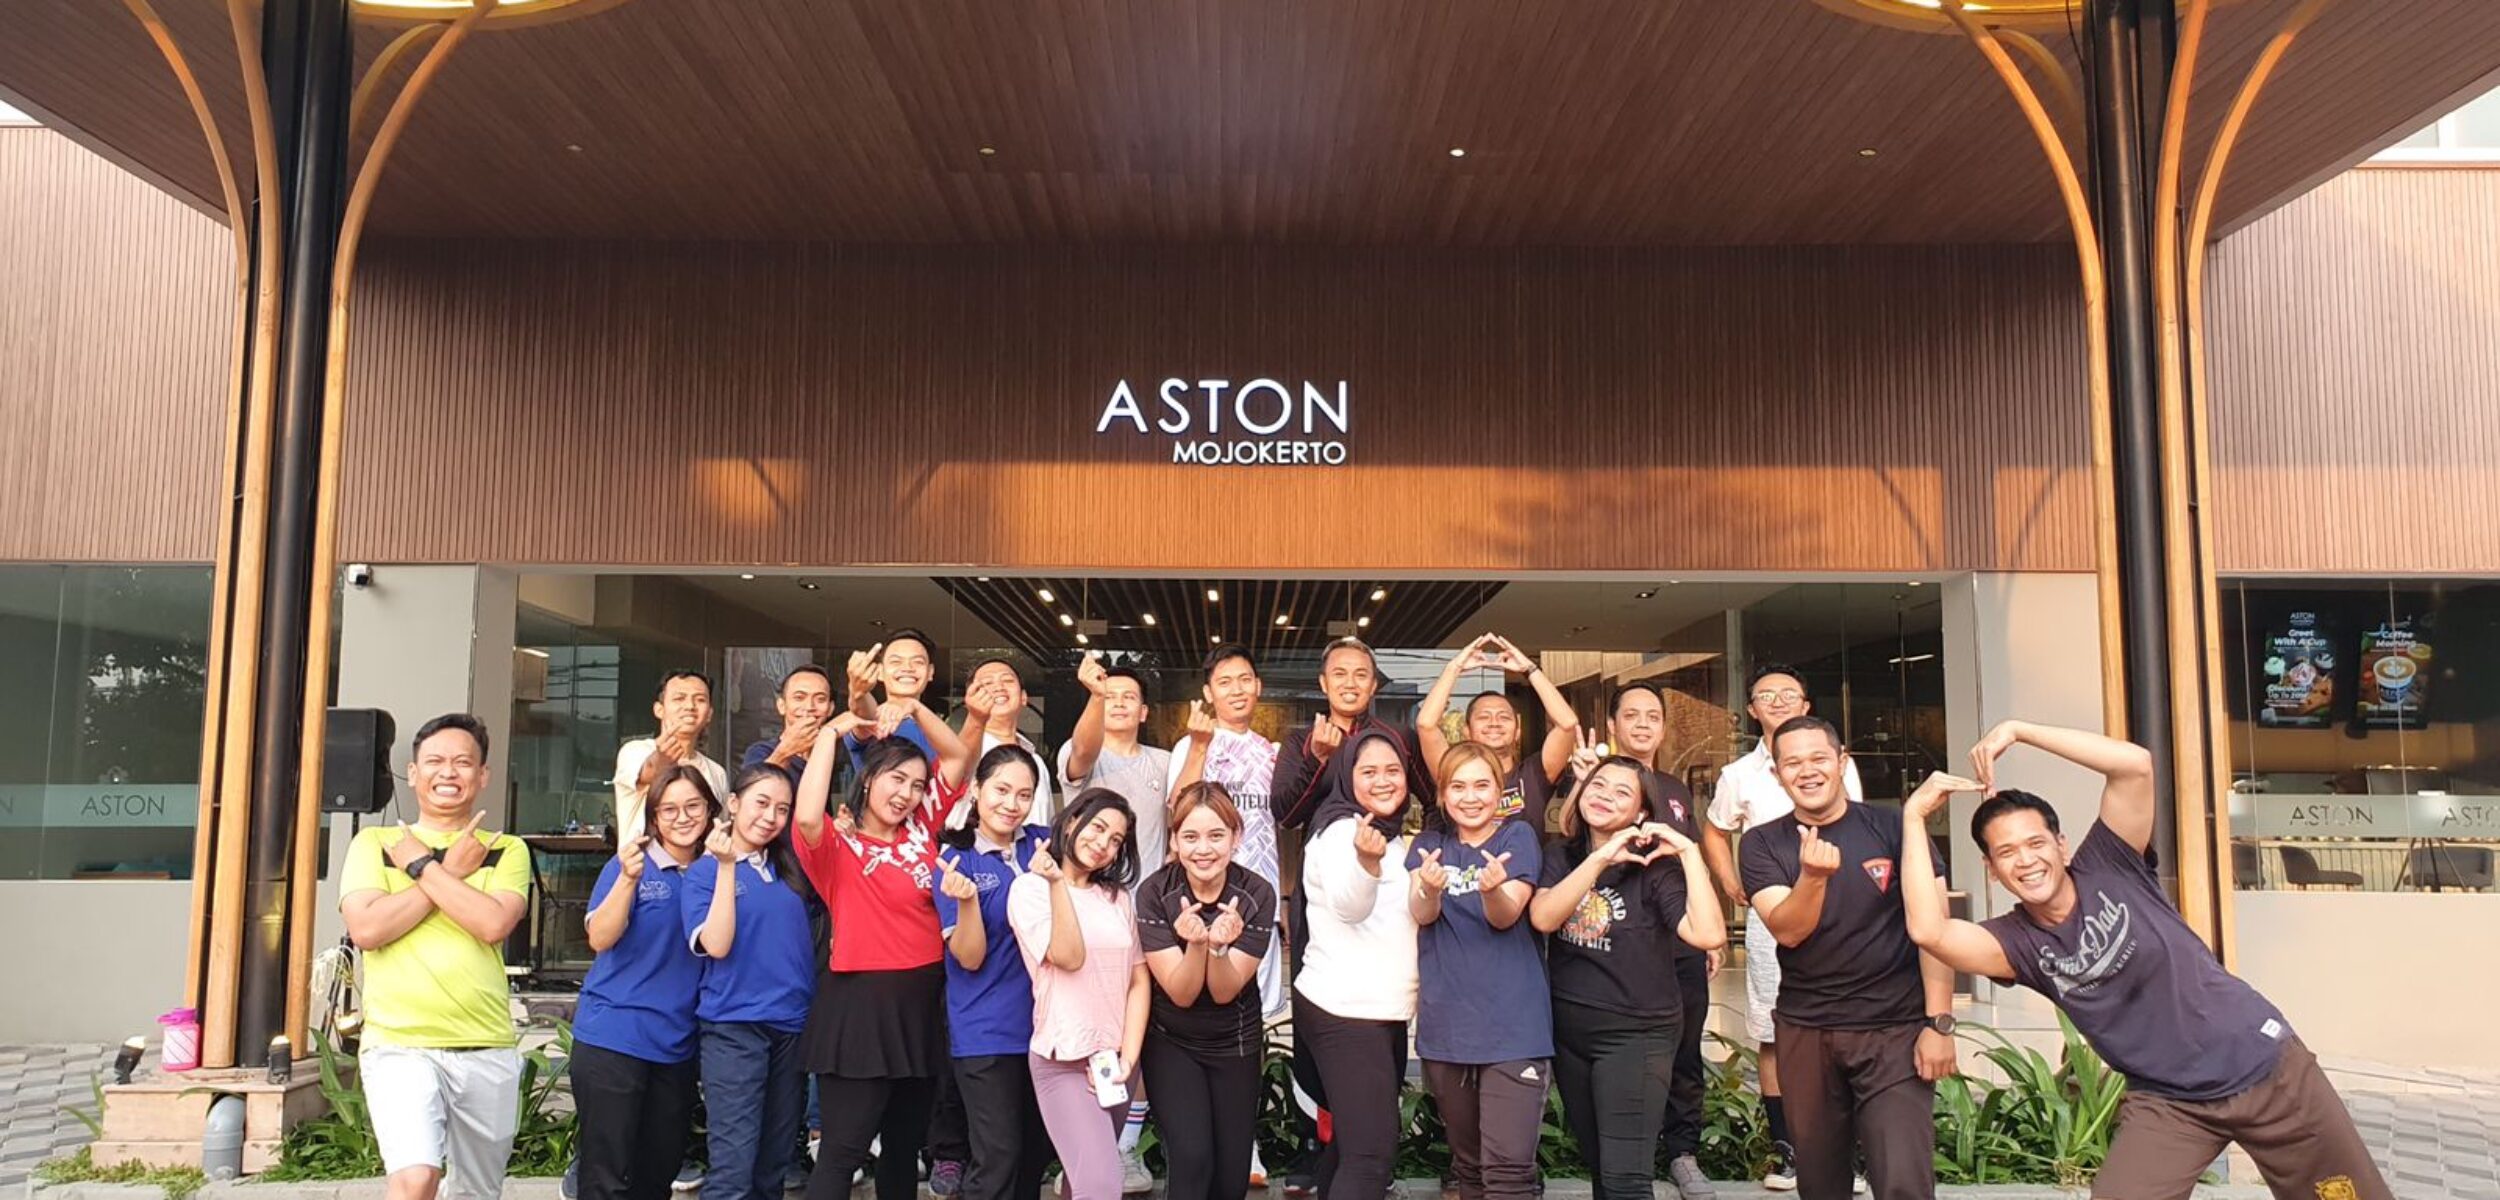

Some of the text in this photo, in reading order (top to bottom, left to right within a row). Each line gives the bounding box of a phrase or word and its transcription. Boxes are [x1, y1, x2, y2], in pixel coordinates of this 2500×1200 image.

[1096, 378, 1348, 434] ASTON
[1172, 441, 1347, 464] MOJOKERTO
[2274, 637, 2297, 646] With
[80, 794, 166, 816] ASTON
[2289, 805, 2374, 827] ASTON
